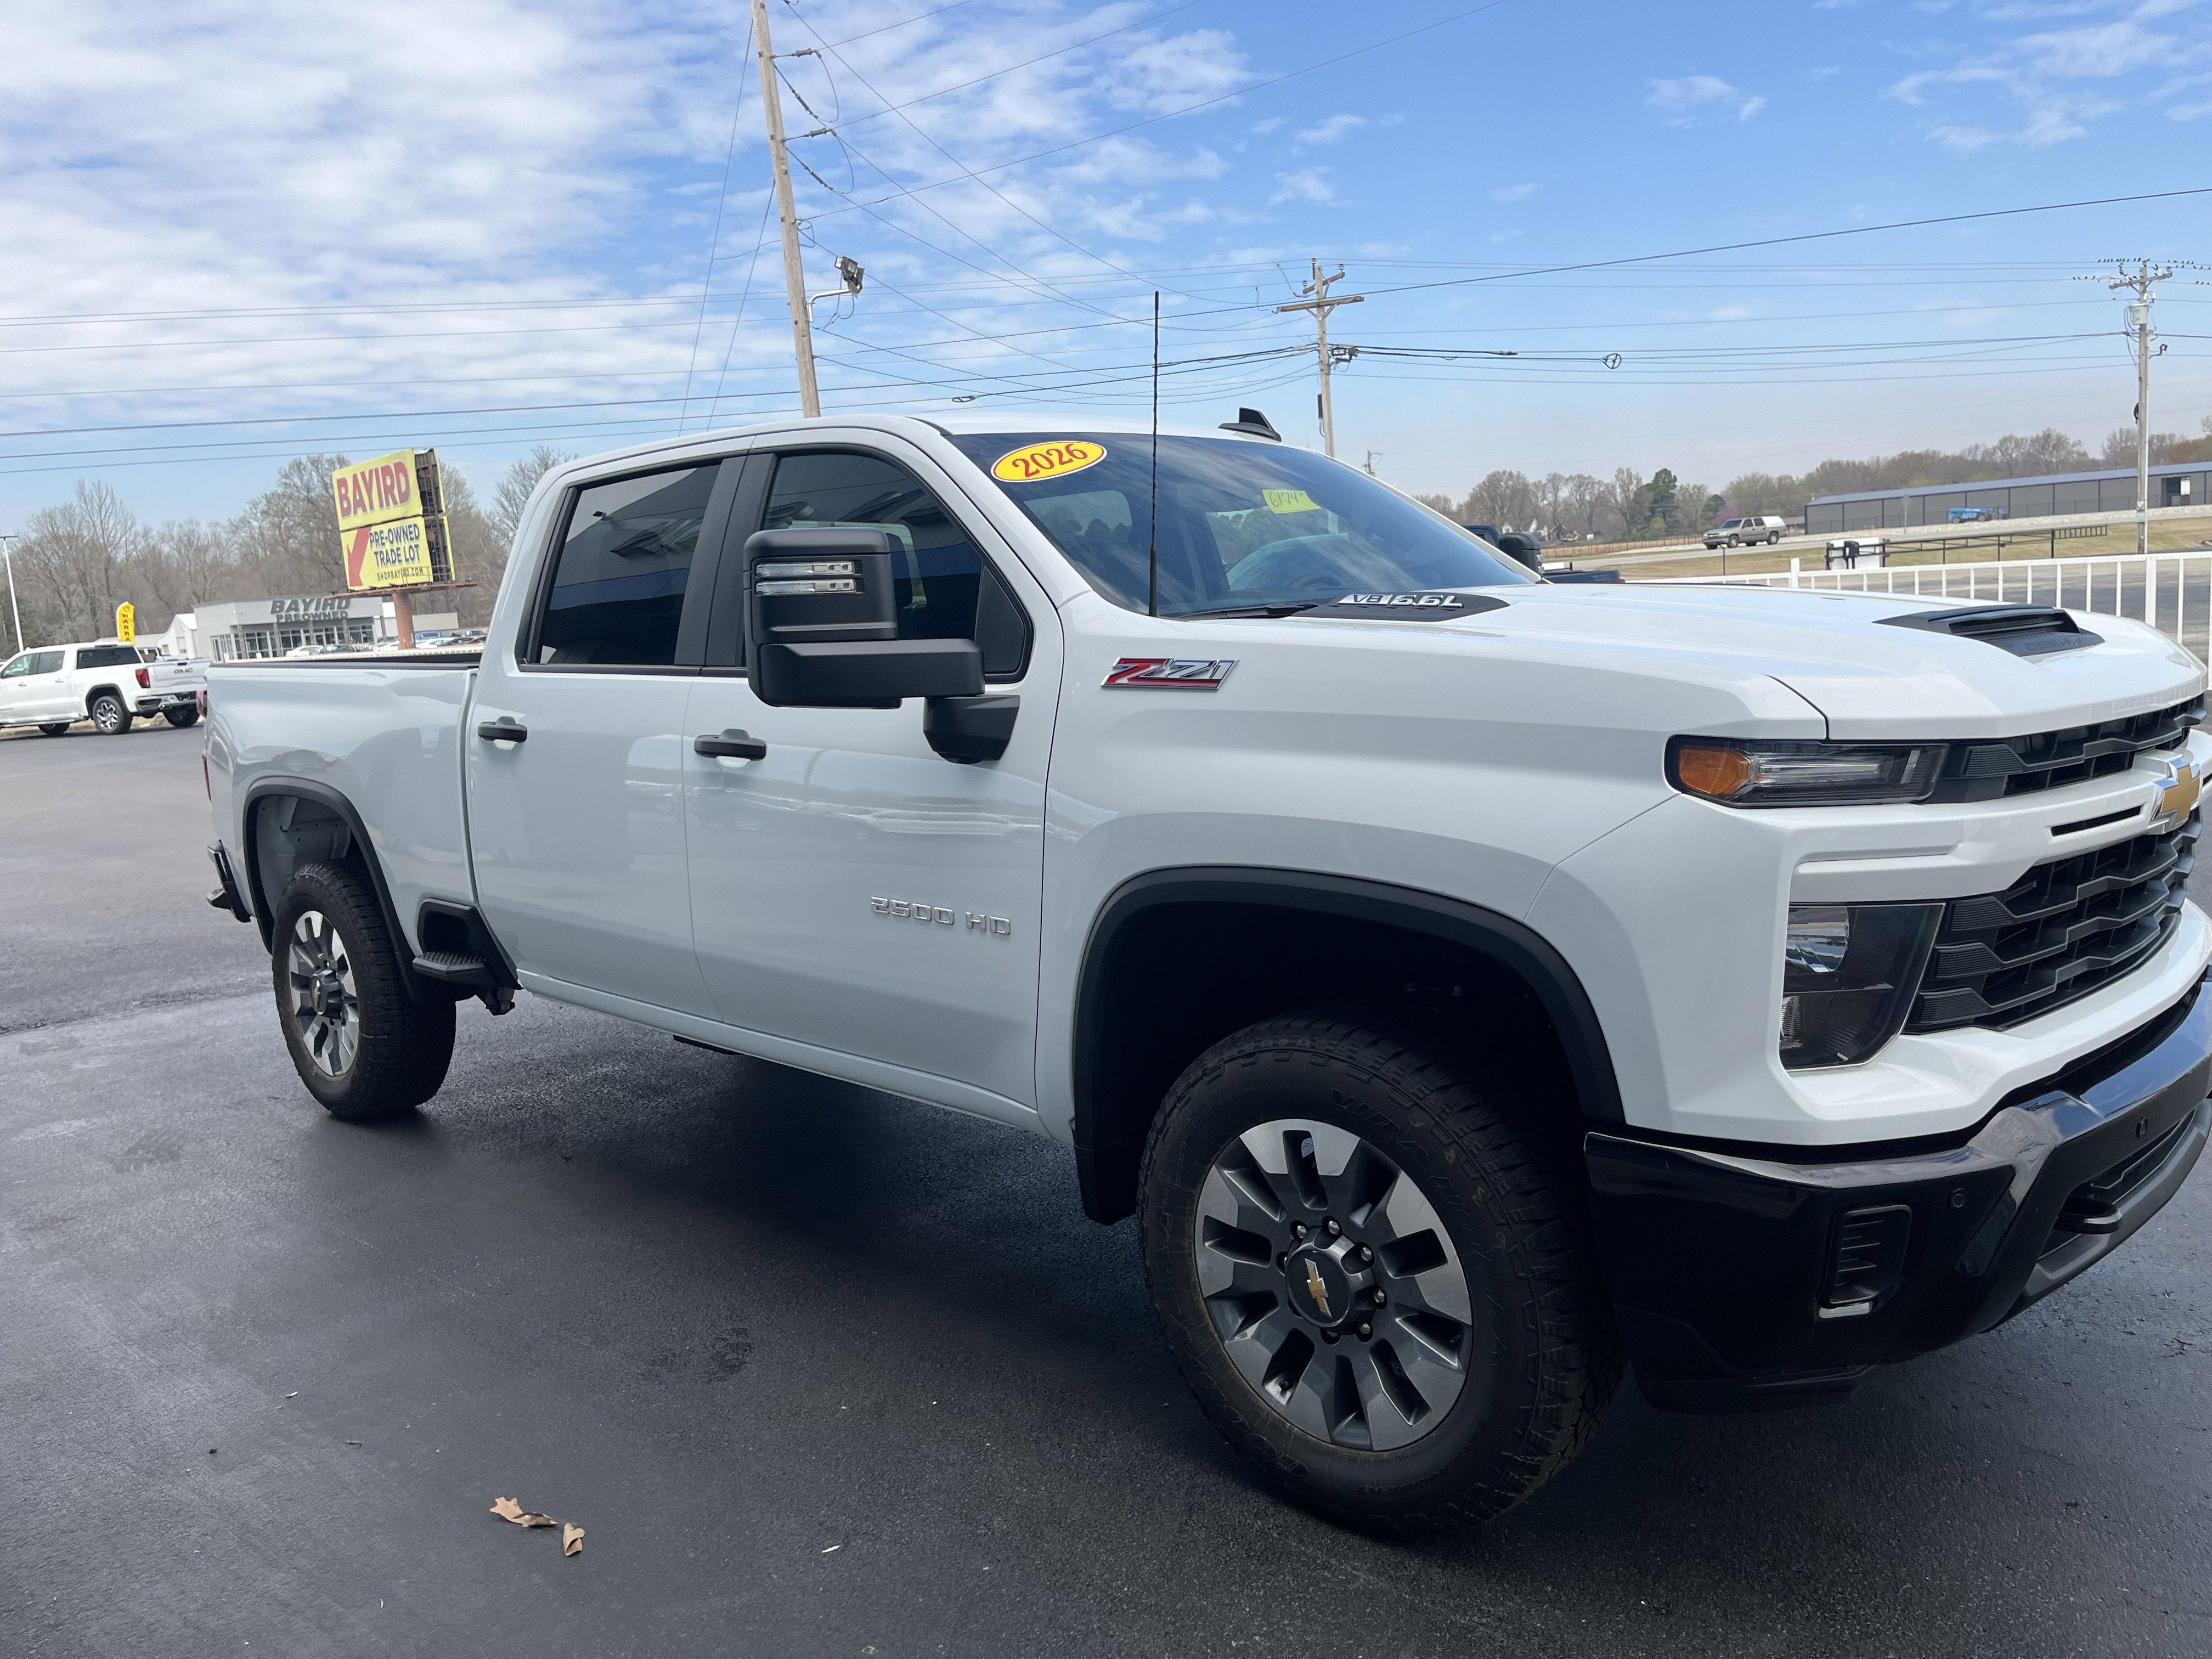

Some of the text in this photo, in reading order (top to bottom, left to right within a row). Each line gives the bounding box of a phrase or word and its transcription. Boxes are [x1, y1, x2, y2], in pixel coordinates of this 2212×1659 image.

[1012, 443, 1088, 478] 2026
[336, 461, 411, 520] BAYIRD
[369, 523, 420, 549] PRE-OWNED
[374, 544, 420, 567] TRADE LOT
[270, 597, 351, 614] BAYIRD
[1353, 594, 1384, 603] V8
[1100, 657, 1240, 691] Z71
[871, 896, 1011, 936] 2500 HD
